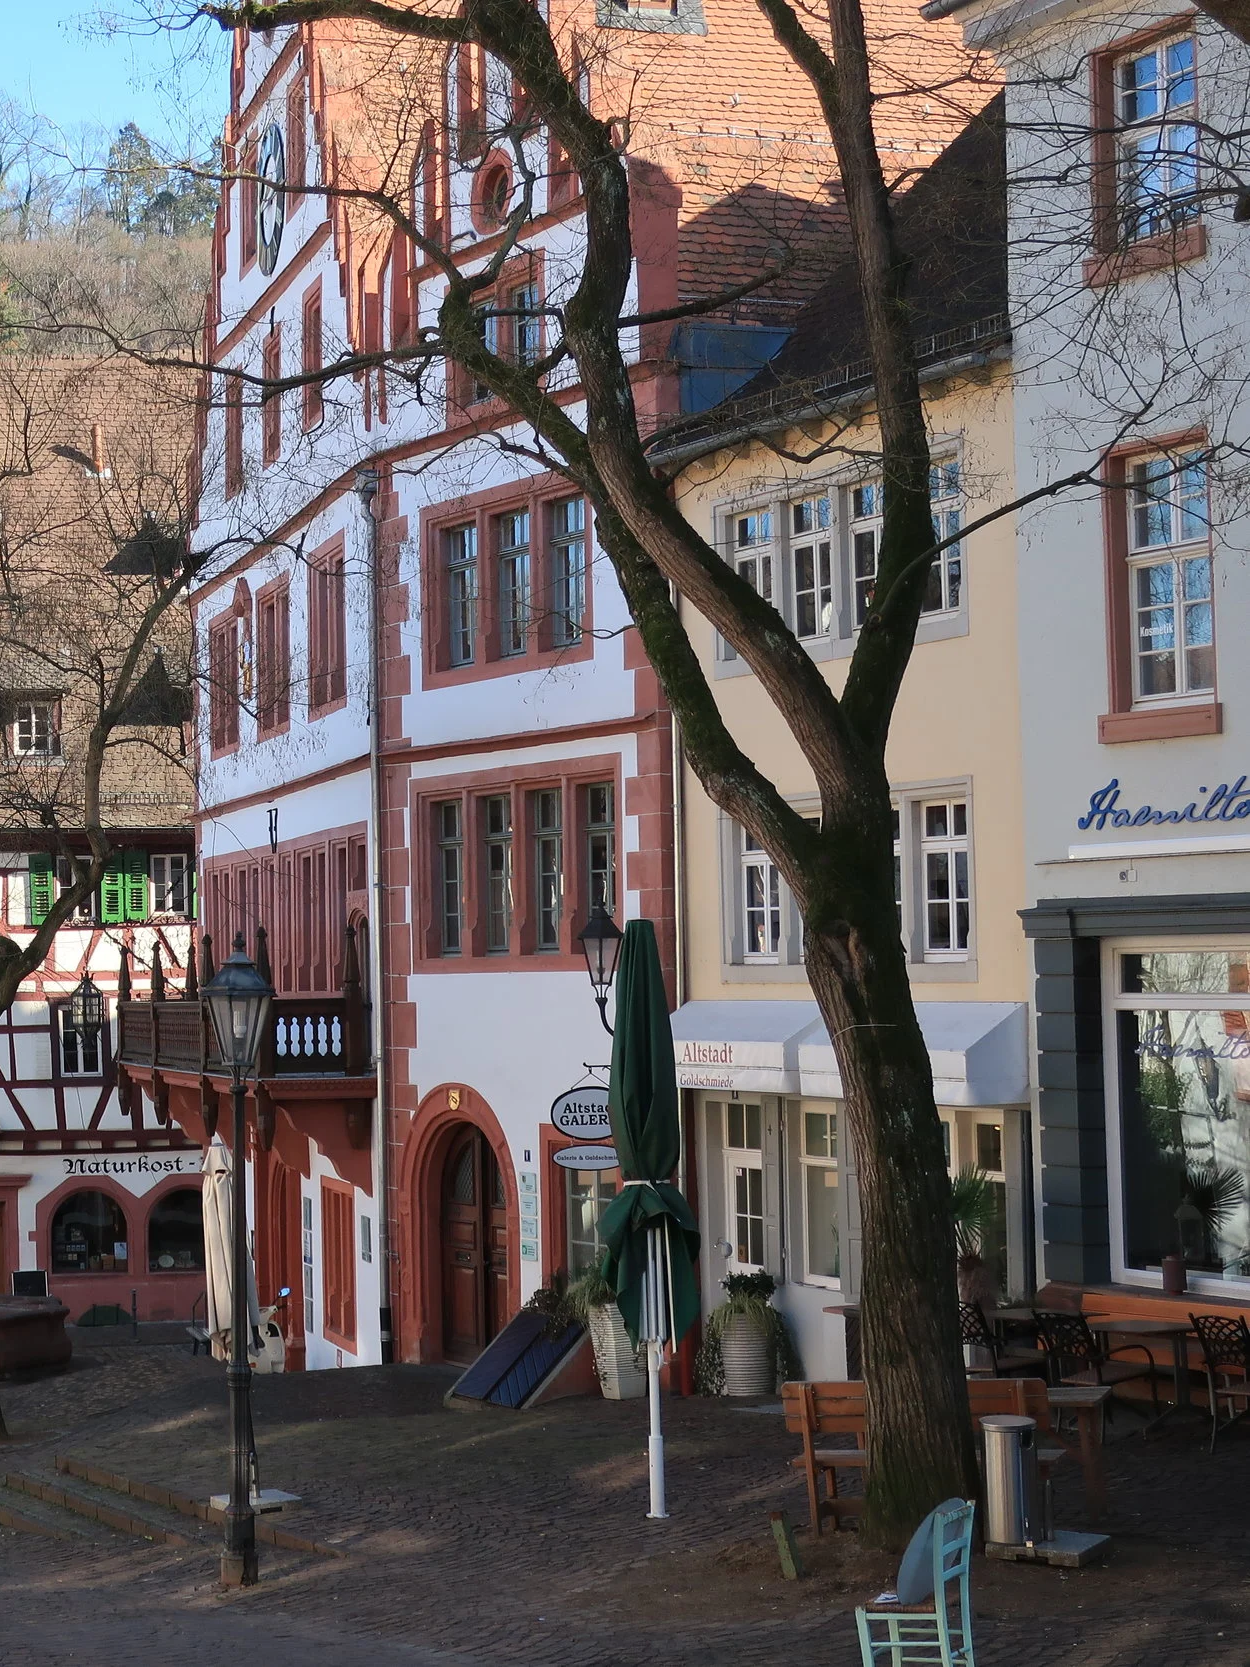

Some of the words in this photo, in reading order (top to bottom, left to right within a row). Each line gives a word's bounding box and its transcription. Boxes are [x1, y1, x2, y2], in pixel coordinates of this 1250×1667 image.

[682, 1042, 733, 1063] Altstadt
[680, 1073, 734, 1088] Goldschmiede
[63, 1155, 184, 1175] Naturkost
